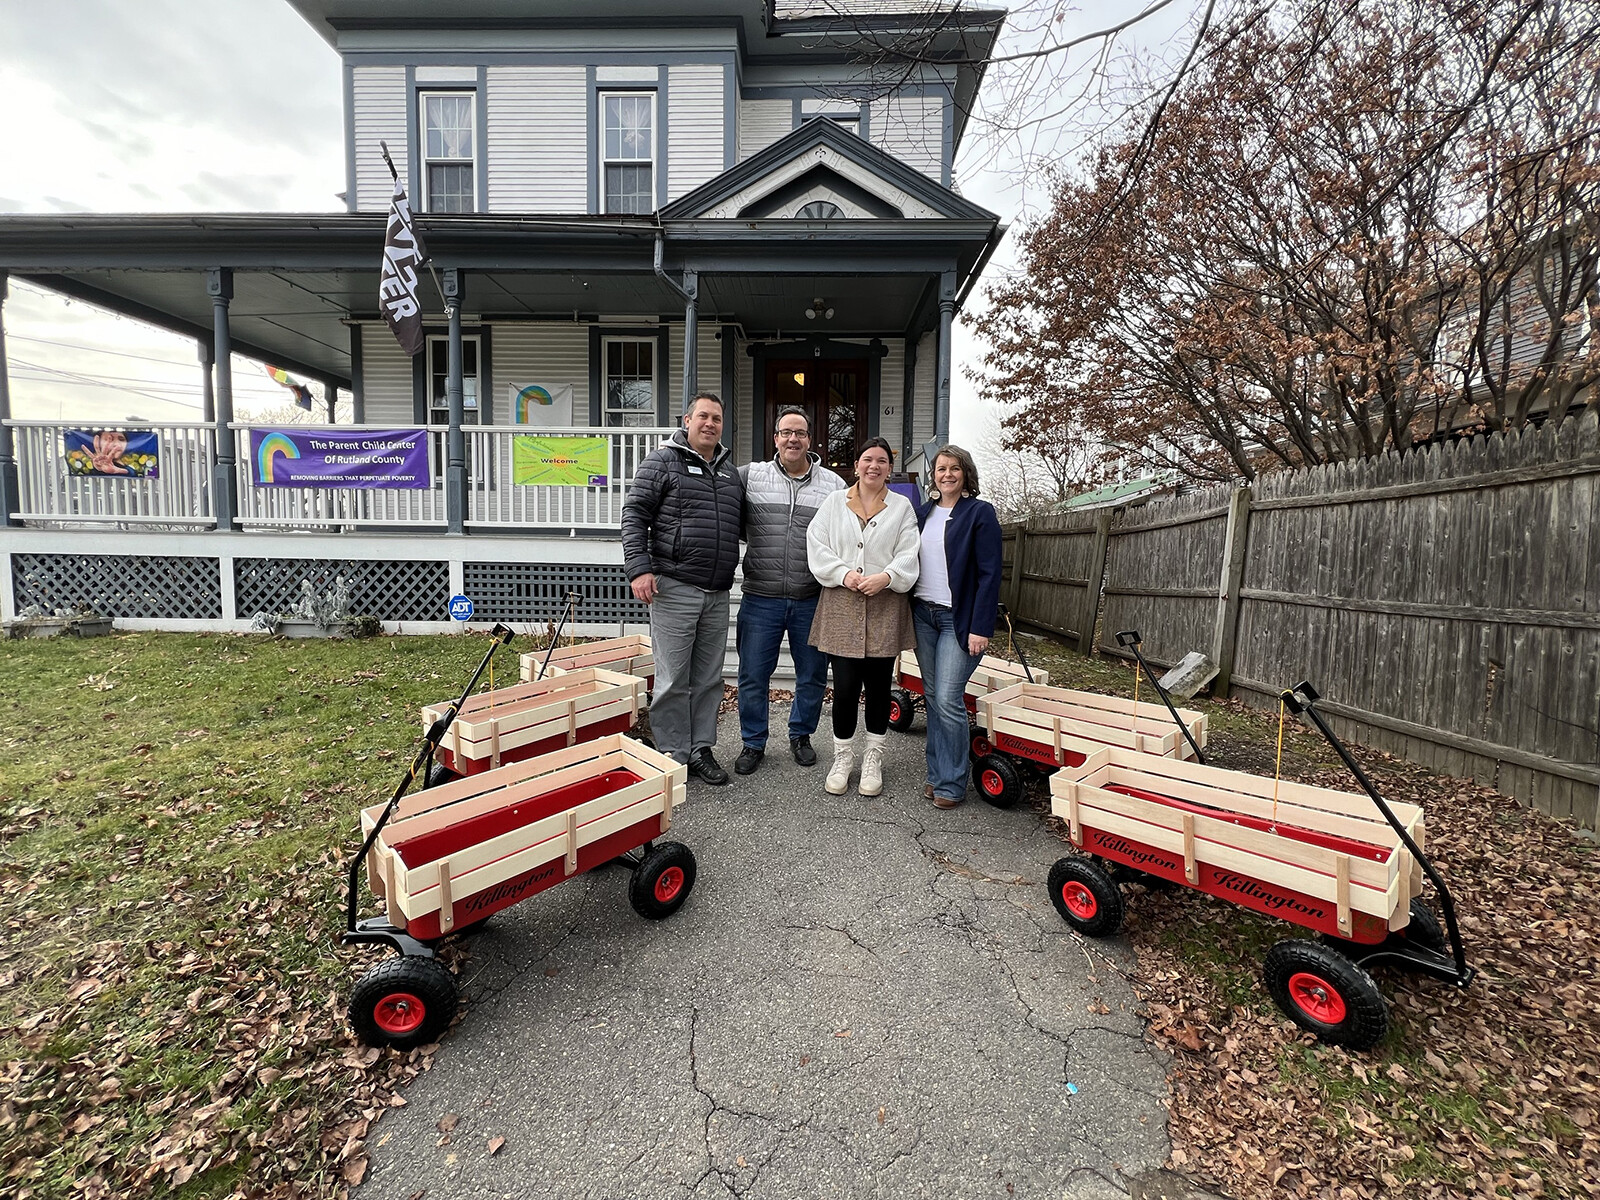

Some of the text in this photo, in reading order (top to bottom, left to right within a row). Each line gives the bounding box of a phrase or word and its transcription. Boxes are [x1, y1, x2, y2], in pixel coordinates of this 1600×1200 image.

[884, 406, 895, 416] 61
[310, 441, 416, 450] The Parent Child Center
[324, 455, 405, 465] Of Rutland County
[452, 602, 470, 612] ADT
[1002, 736, 1051, 758] Killington
[1093, 832, 1328, 920] Killington Killington
[465, 868, 555, 916] Killington
